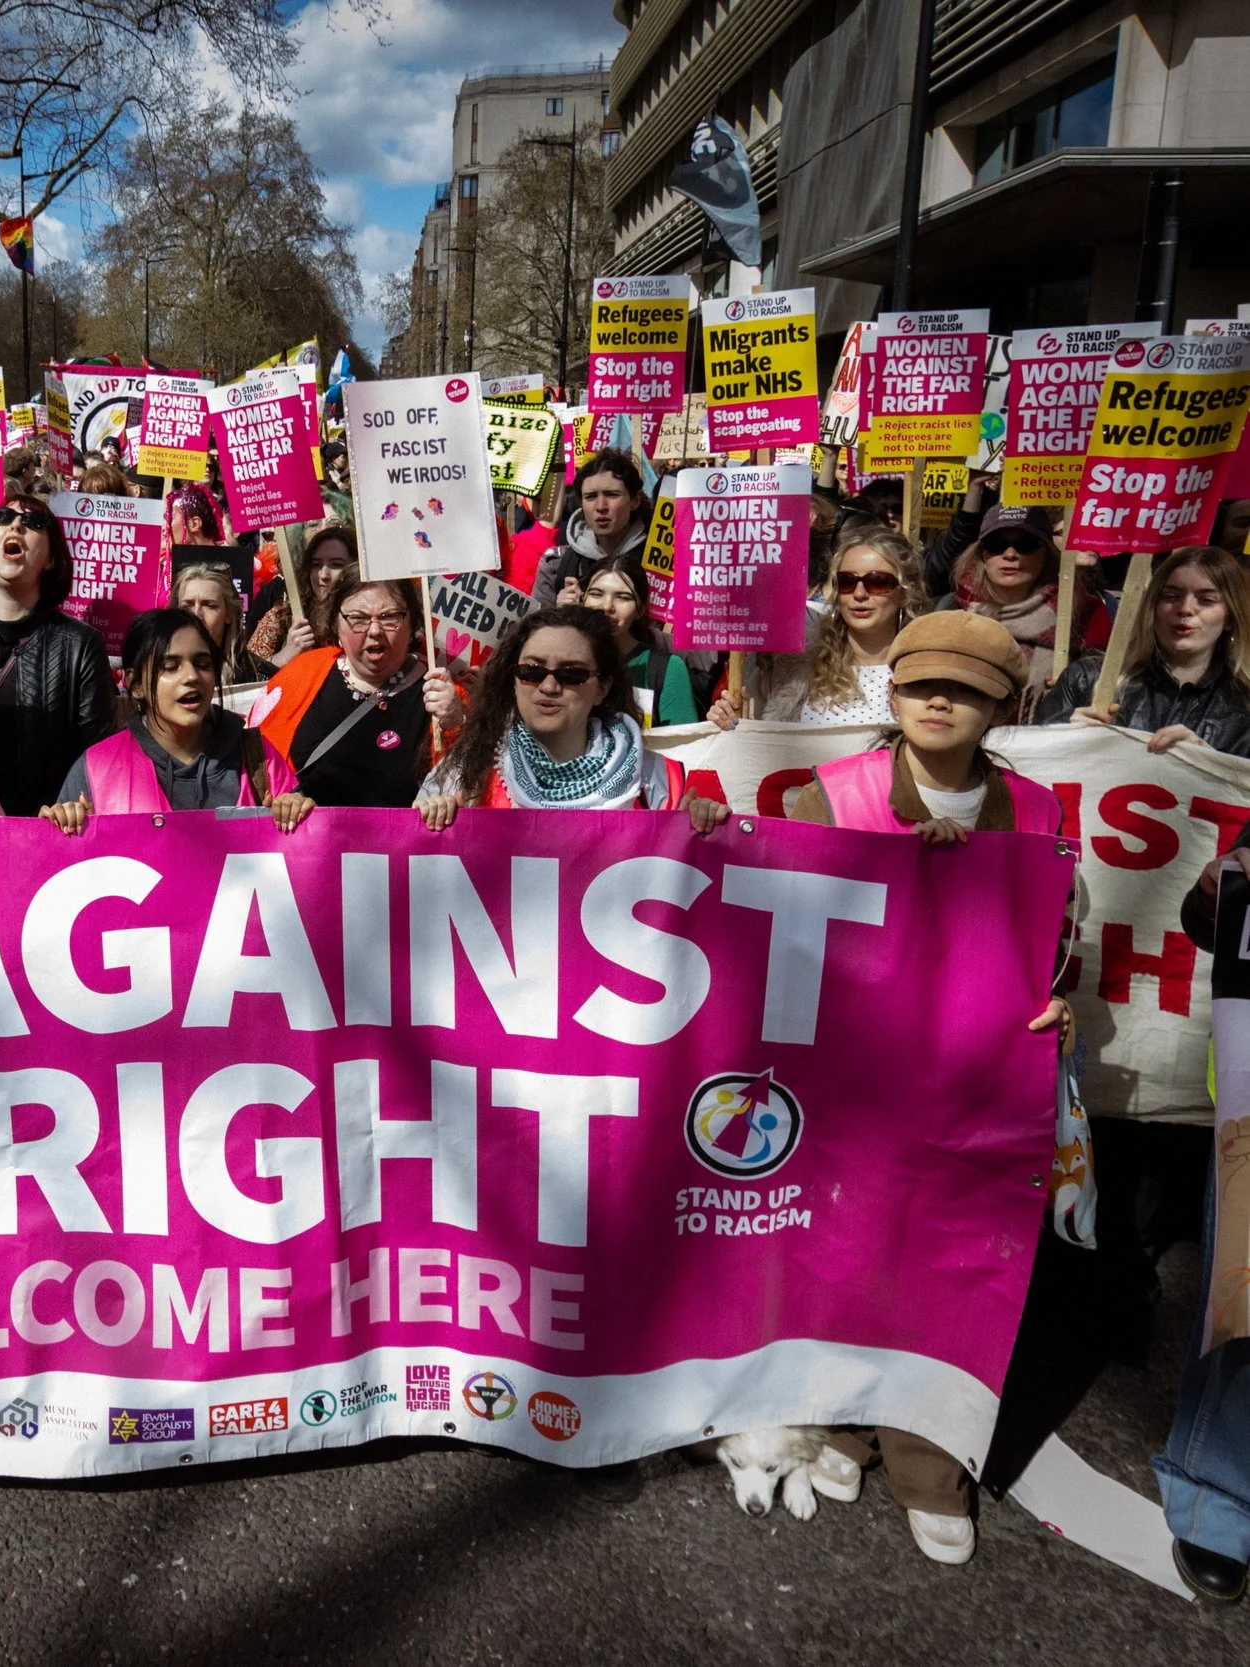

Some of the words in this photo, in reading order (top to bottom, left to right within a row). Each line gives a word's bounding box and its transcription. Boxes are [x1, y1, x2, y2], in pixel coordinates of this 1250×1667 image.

[747, 298, 774, 309] STAND
[775, 296, 787, 306] UP
[748, 309, 760, 318] TO
[760, 305, 792, 317] RACISM
[597, 305, 685, 327] Refugees
[918, 315, 945, 324] STAND
[946, 314, 959, 323] UP
[597, 327, 679, 346] welcome
[918, 324, 929, 333] TO
[930, 322, 963, 333] RACISM
[1066, 331, 1102, 343] STAND
[1105, 330, 1120, 340] UP
[709, 323, 810, 354] Migrants
[884, 337, 969, 358] WOMEN
[1178, 343, 1224, 356] STAND
[1225, 341, 1243, 354] UP
[594, 357, 637, 380] Stop
[641, 356, 674, 376] the
[711, 353, 772, 378] make
[882, 356, 978, 376] AGAINST
[1176, 357, 1196, 369] TO
[1198, 356, 1243, 369] RACISM
[593, 379, 622, 398] far
[625, 379, 672, 402] right
[712, 381, 750, 401] our
[755, 370, 803, 397] NHS
[881, 394, 948, 413] RIGHT
[1108, 380, 1250, 418] Refugees
[221, 401, 283, 430] WOMEN
[363, 410, 395, 428] SOD
[406, 408, 439, 425] OFF,
[713, 409, 744, 424] Stop
[746, 406, 769, 420] the
[1018, 409, 1073, 430] THE
[227, 417, 294, 448] AGAINST
[884, 420, 917, 432] Reject
[920, 420, 952, 430] racist
[953, 419, 973, 429] lies
[1102, 418, 1232, 447] welcome
[884, 432, 932, 443] Refugees
[936, 433, 952, 441] are
[381, 438, 447, 458] FASCIST
[232, 458, 279, 482] RIGHT
[387, 465, 467, 484] WEIRDOS!
[731, 473, 760, 482] STAND
[762, 472, 777, 481] UP
[1021, 463, 1064, 474] Reject
[731, 483, 742, 493] TO
[743, 482, 780, 492] RACISM
[1087, 463, 1166, 501] Stop
[1174, 465, 1214, 494] the
[1019, 491, 1043, 499] not
[1046, 490, 1061, 499] to
[691, 498, 779, 521] WOMEN
[1080, 498, 1131, 528] far
[1135, 497, 1202, 535] right
[62, 520, 136, 545] WOMEN
[690, 520, 793, 542] AGAINST
[689, 544, 733, 565] THE
[738, 543, 782, 564] FAR
[689, 565, 758, 587] RIGHT
[450, 571, 488, 601] ALL
[496, 585, 531, 618] YOU
[694, 591, 731, 604] Reject
[432, 586, 496, 632] NEED
[693, 604, 728, 616] racist
[729, 605, 750, 616] lies
[693, 619, 745, 634] Refugees
[748, 622, 768, 632] are
[692, 633, 712, 645] not
[714, 634, 727, 645] to
[729, 634, 764, 646] blame
[675, 1187, 762, 1211] STAND
[768, 1185, 802, 1209] UP
[674, 1212, 708, 1236] TO
[714, 1208, 812, 1236] RACISM
[329, 1247, 586, 1351] HERE
[340, 1381, 368, 1398] STOP
[419, 1380, 450, 1389] music
[340, 1395, 362, 1408] THE
[363, 1384, 388, 1399] WAR
[481, 1391, 499, 1399] DPAC
[44, 1405, 78, 1416] MUSLIM
[142, 1412, 175, 1423] JEWISH
[211, 1402, 266, 1423] CARE
[268, 1400, 281, 1416] 4
[535, 1399, 579, 1419] HOMES
[43, 1416, 98, 1431] ASSOCIATION
[142, 1419, 192, 1431] SOCIALISTS
[212, 1414, 286, 1436] CALAIS
[529, 1408, 556, 1428] FOR
[556, 1416, 580, 1433] ALL
[142, 1430, 176, 1440] GROUP
